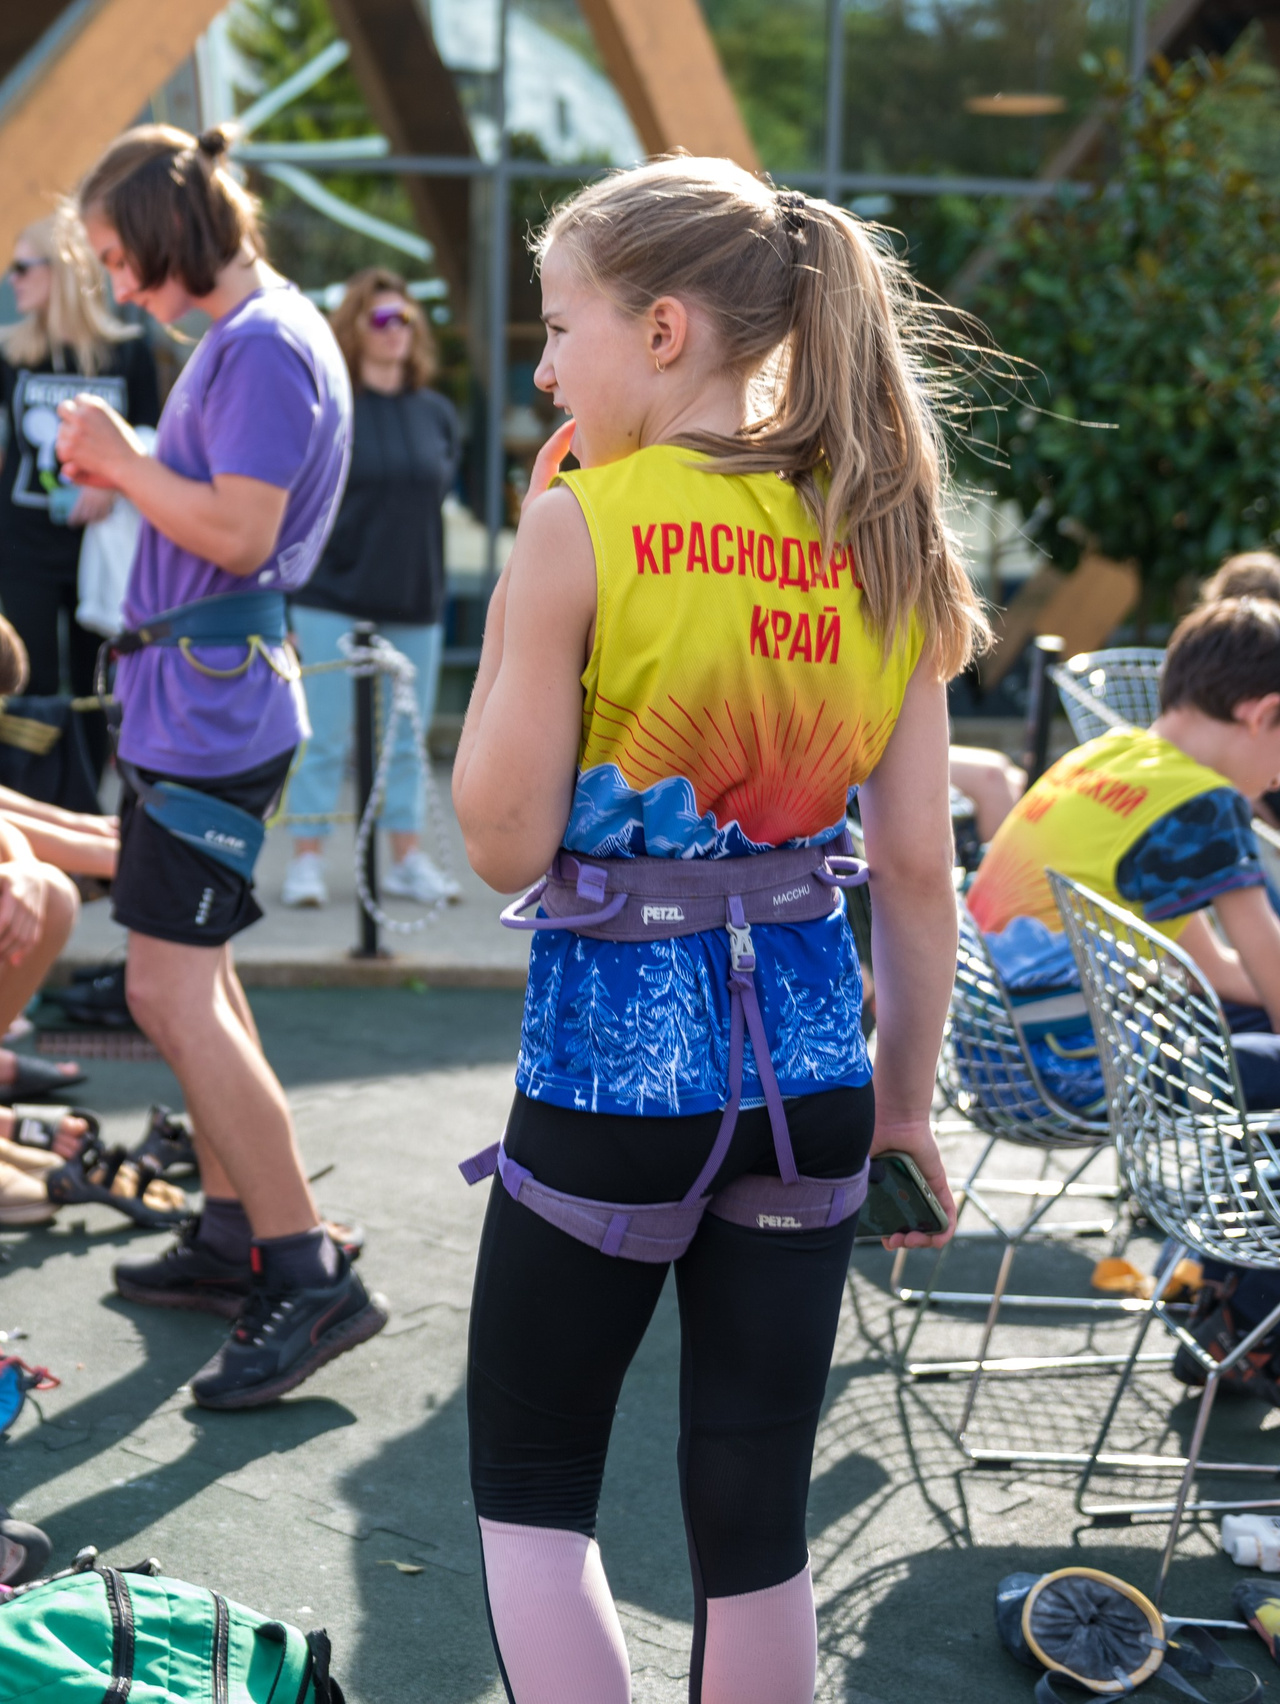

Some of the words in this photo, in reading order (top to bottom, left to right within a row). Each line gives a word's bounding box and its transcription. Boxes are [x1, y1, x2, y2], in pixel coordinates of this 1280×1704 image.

[750, 604, 841, 665] КРАЙ
[772, 884, 811, 906] MACCHU
[642, 904, 685, 926] PETZL
[757, 1213, 802, 1229] PETZL
